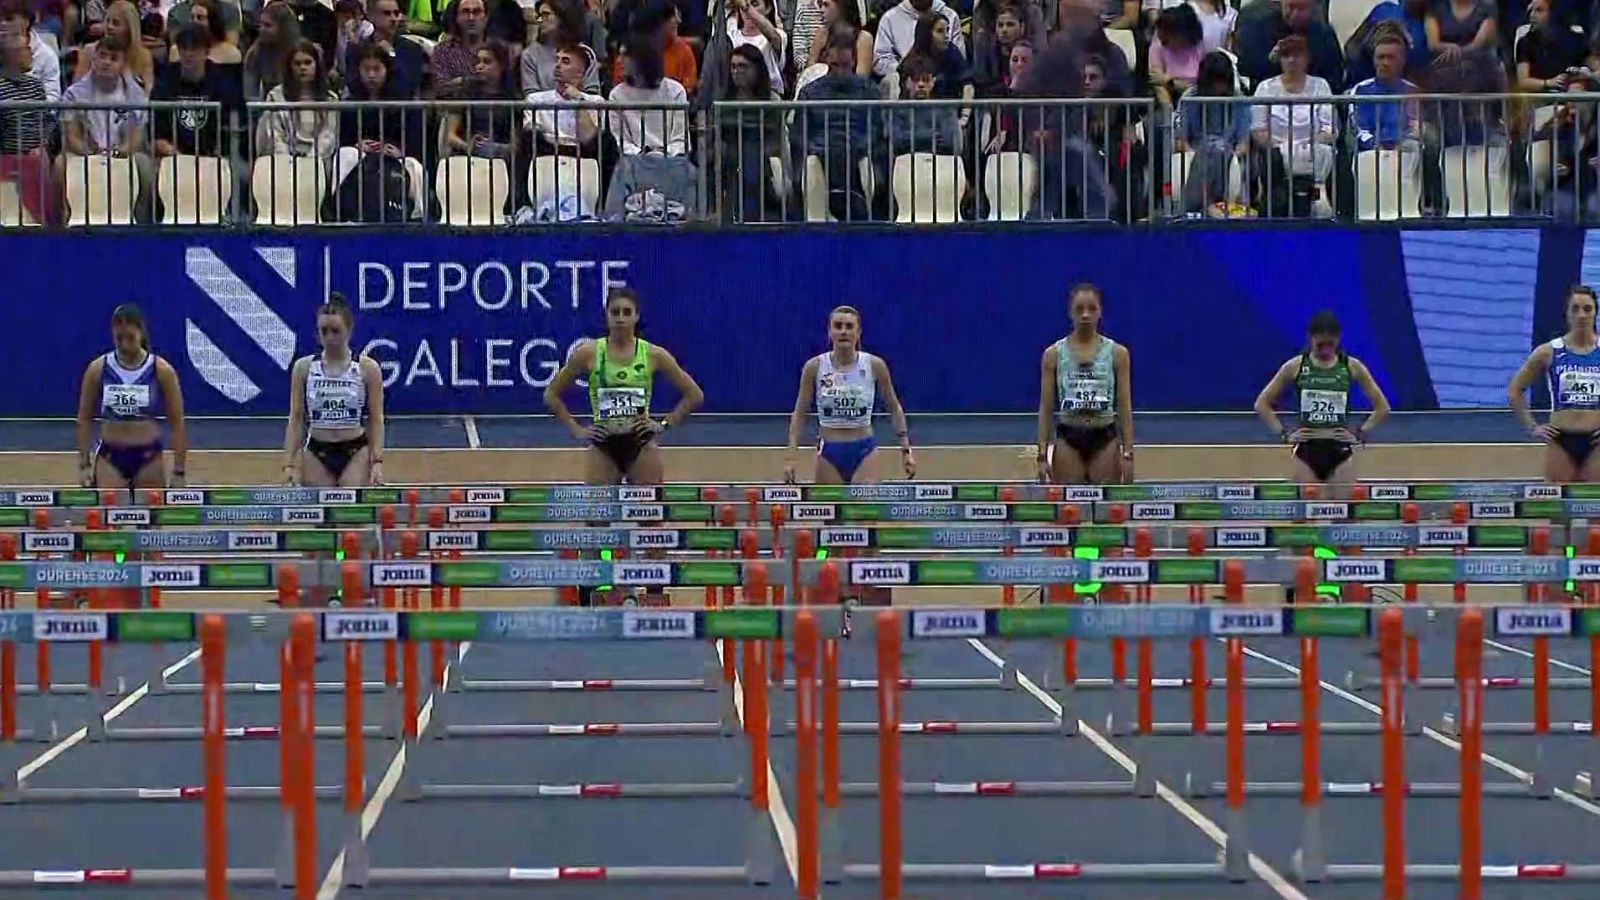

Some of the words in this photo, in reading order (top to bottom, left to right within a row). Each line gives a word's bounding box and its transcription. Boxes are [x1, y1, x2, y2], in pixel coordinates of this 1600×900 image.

[1571, 383, 1595, 393] 461
[113, 394, 137, 405] 366
[611, 395, 633, 407] 351
[1075, 391, 1097, 401] 487
[322, 399, 346, 410] 404
[834, 397, 857, 407] 507
[1311, 401, 1335, 412] 326
[37, 569, 97, 582] OURENSE
[99, 569, 129, 582] 2024
